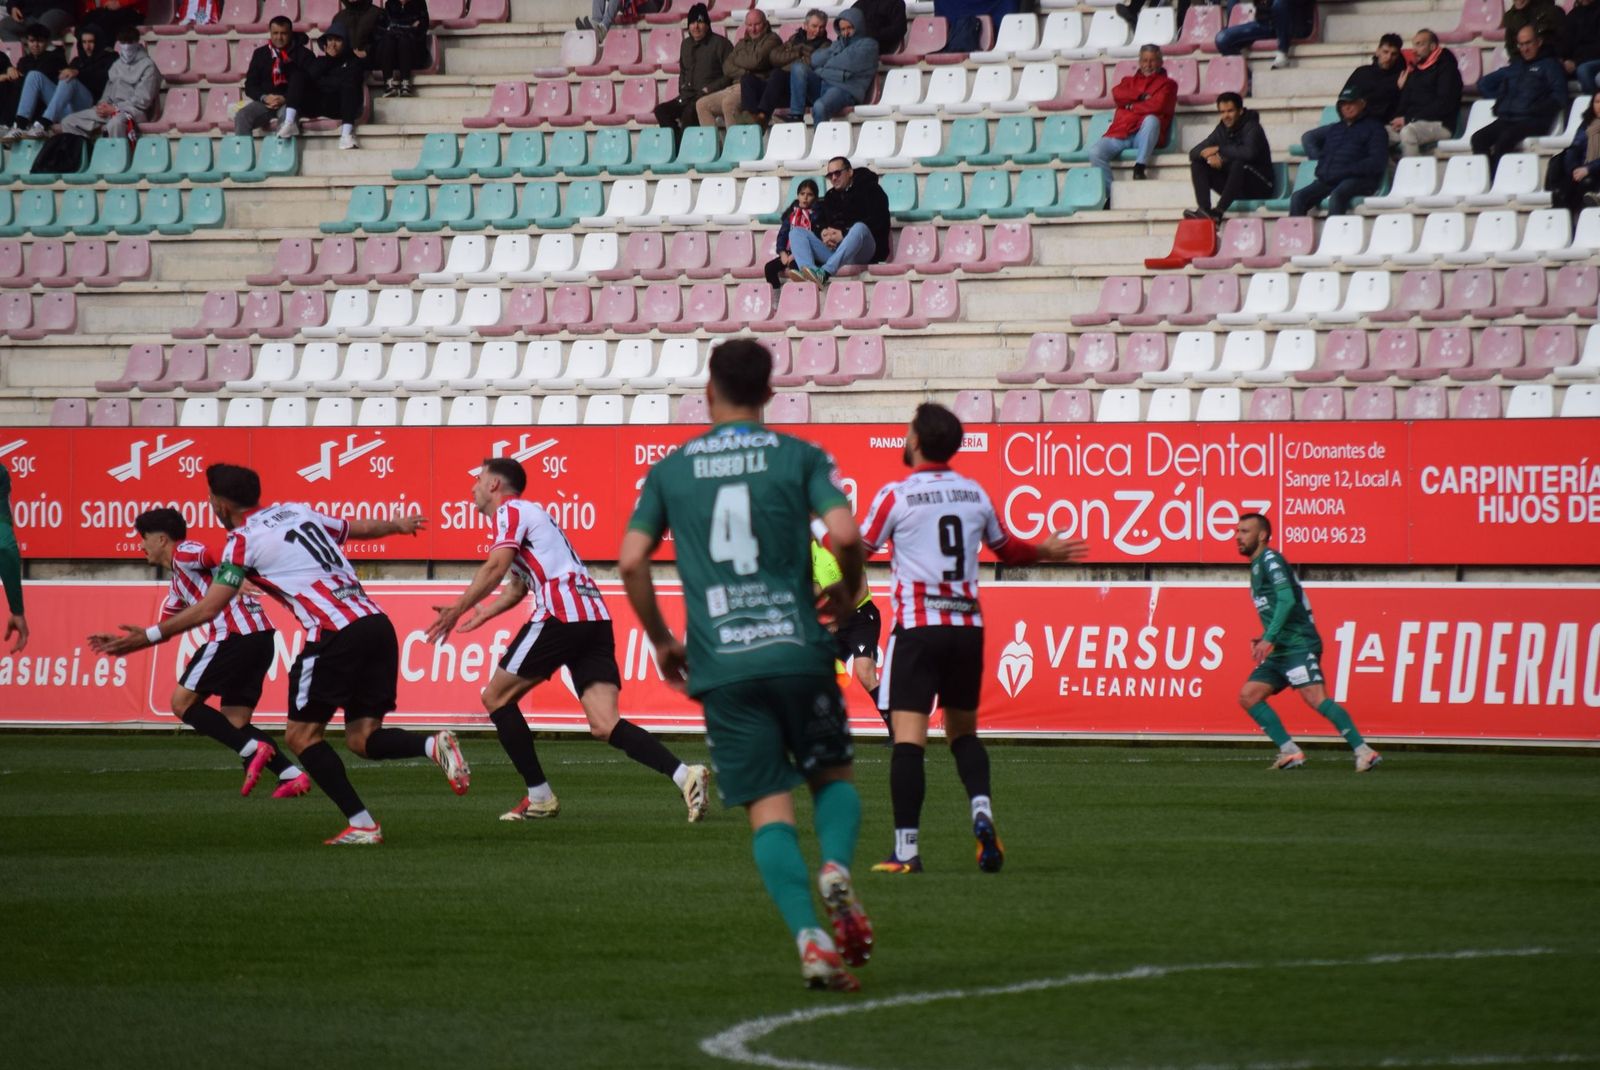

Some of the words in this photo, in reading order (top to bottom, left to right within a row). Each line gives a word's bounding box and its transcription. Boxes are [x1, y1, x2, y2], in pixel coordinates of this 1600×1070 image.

[869, 437, 906, 448] PANAD
[1004, 430, 1131, 476] Clínica
[1147, 432, 1274, 476] Dental
[1303, 442, 1365, 459] Donantes
[1368, 442, 1385, 459] de
[11, 456, 36, 478] sgc
[178, 456, 203, 478] sgc
[369, 456, 394, 478] sgc
[542, 456, 567, 478] sgc
[1285, 471, 1330, 491] Sangre
[1355, 471, 1388, 488] Local
[1391, 471, 1402, 488] A
[1285, 499, 1345, 515] ZAMORA
[1478, 494, 1560, 523] HIJOS
[709, 483, 759, 576] 4
[1285, 528, 1310, 544] 980
[1311, 528, 1328, 544] 04
[1330, 528, 1347, 544] 96
[1350, 528, 1366, 544] 23
[284, 521, 344, 573] 10
[938, 514, 965, 581] 9
[1044, 625, 1226, 670] VERSUS
[1059, 676, 1203, 698] E-LEARNING
